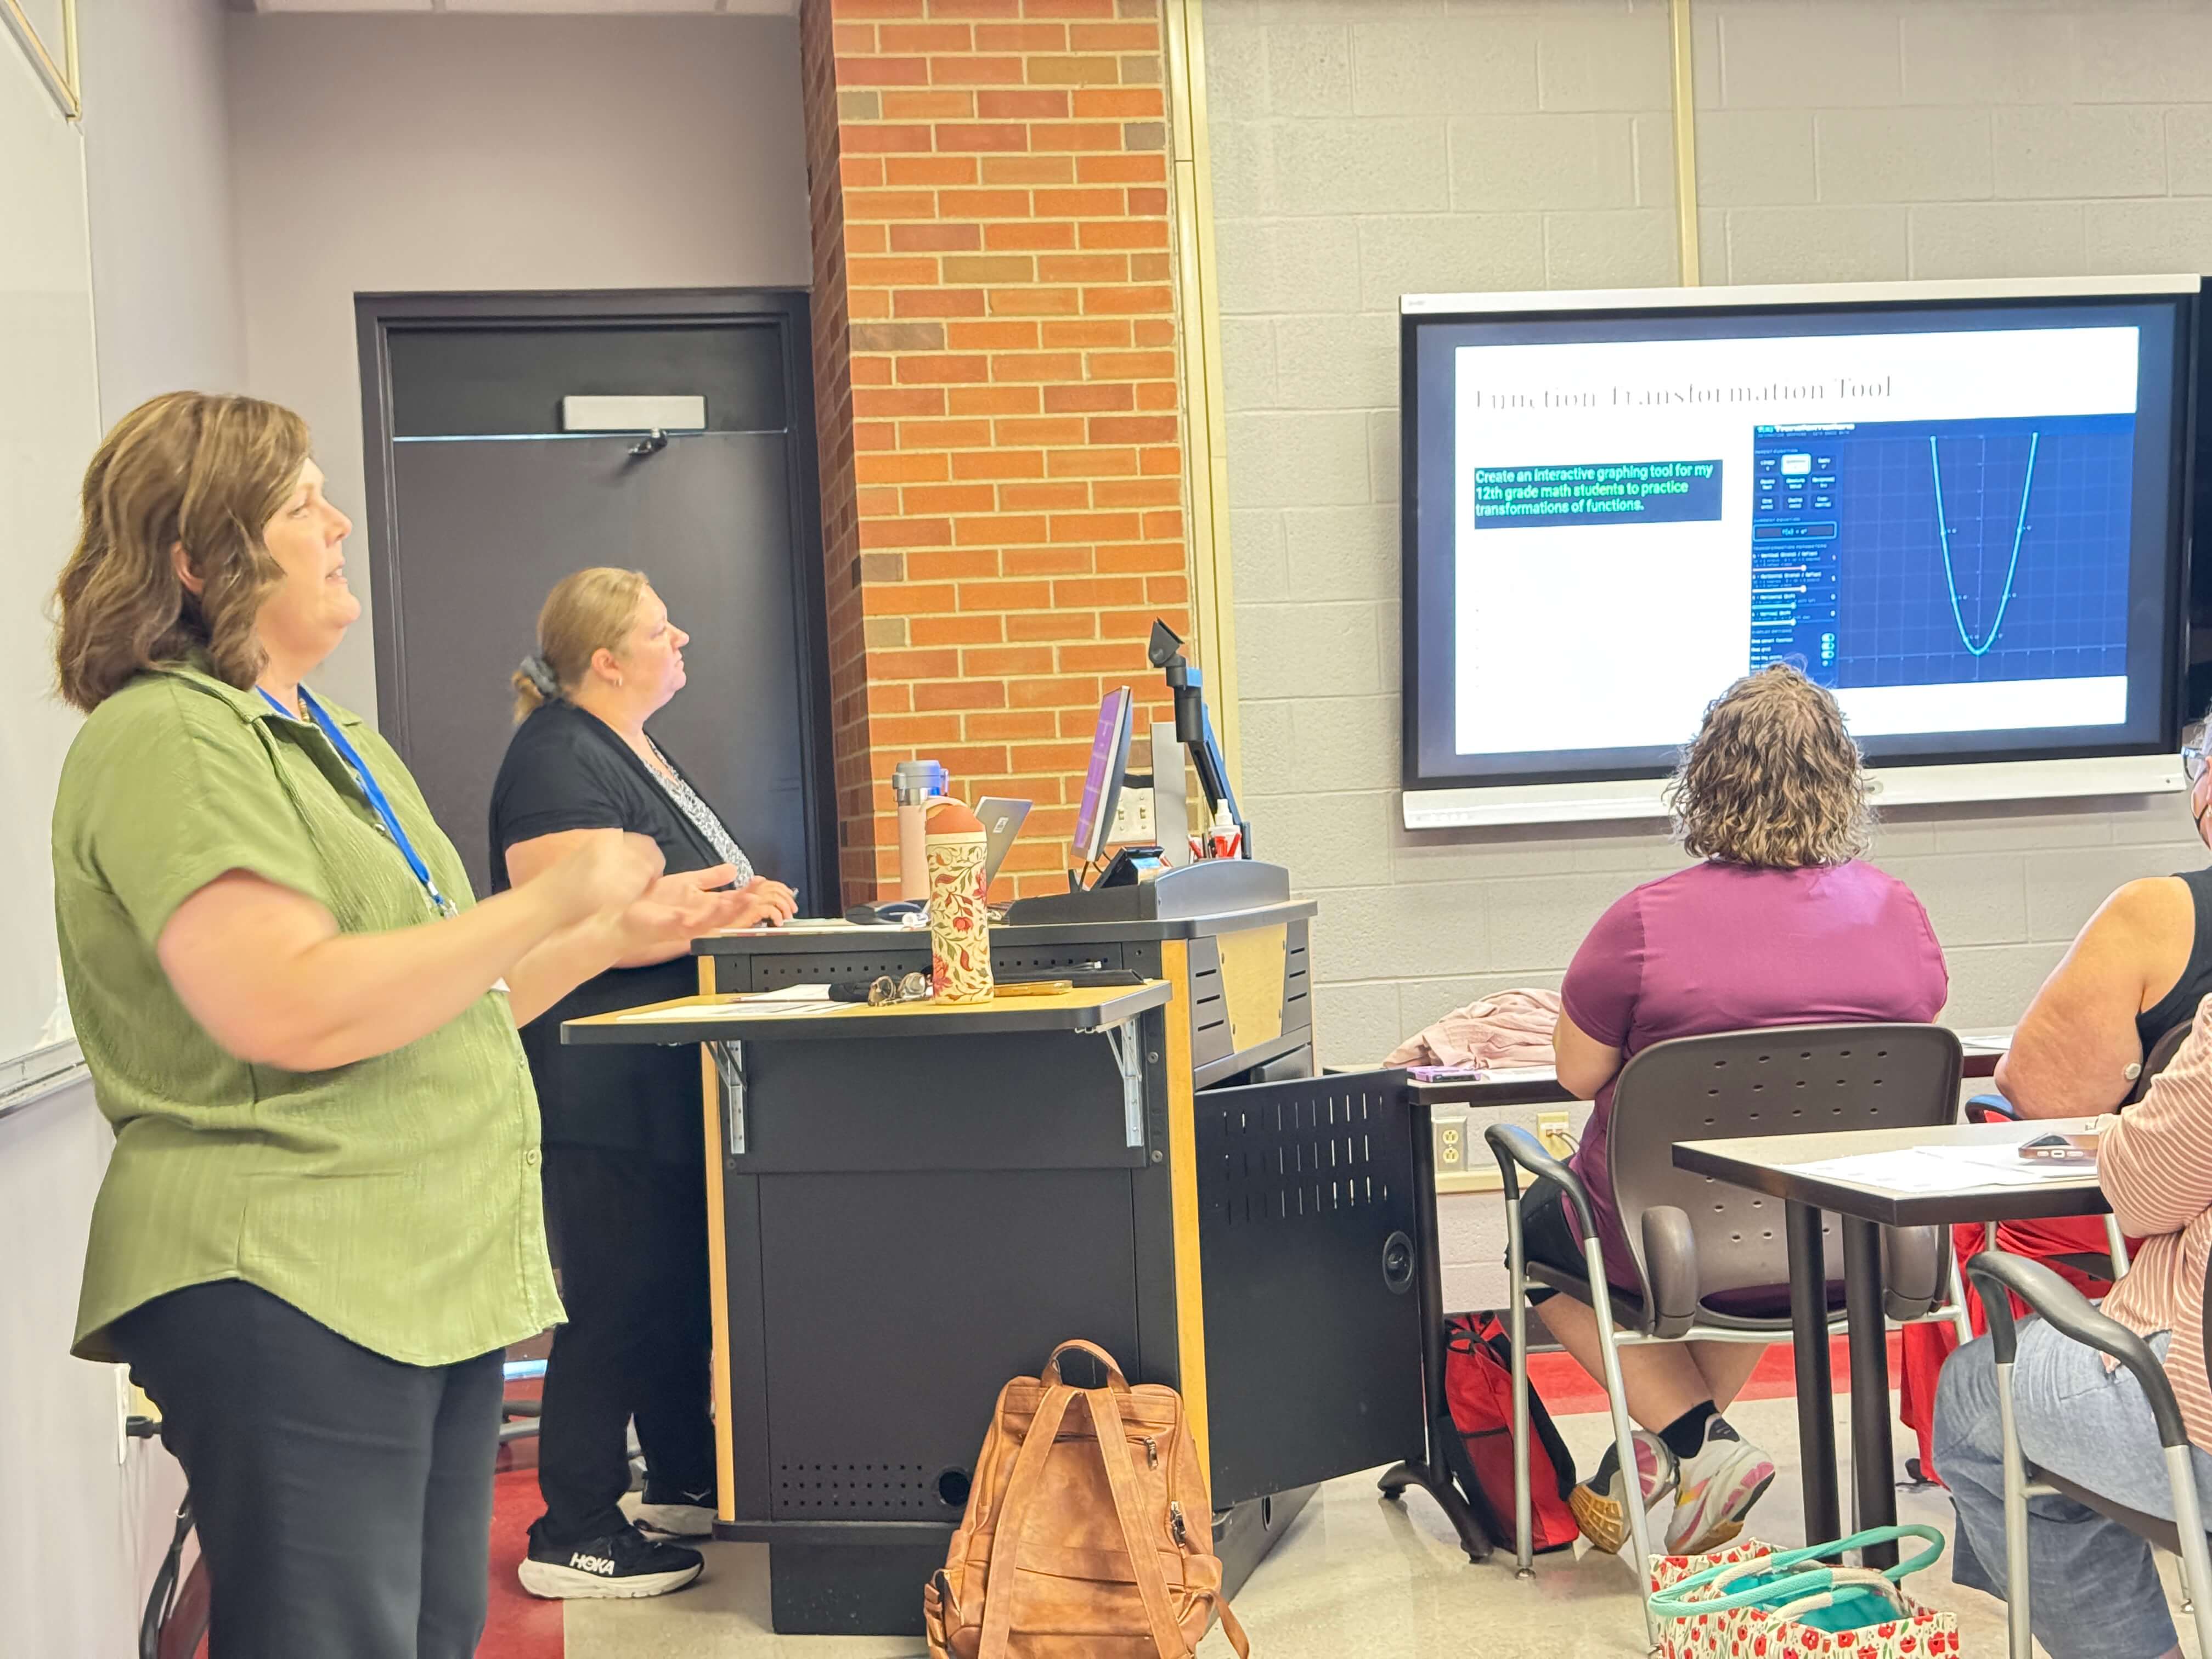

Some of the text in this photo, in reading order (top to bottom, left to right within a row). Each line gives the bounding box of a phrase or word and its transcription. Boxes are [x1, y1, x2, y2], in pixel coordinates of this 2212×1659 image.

[1834, 375, 1891, 398] Tool
[1475, 462, 1713, 483] Create an interactive graphing tool for my
[1475, 480, 1689, 501] 12th grade math students to practice
[1475, 498, 1645, 516] transformations of functions.
[569, 1552, 615, 1576] HOKA
